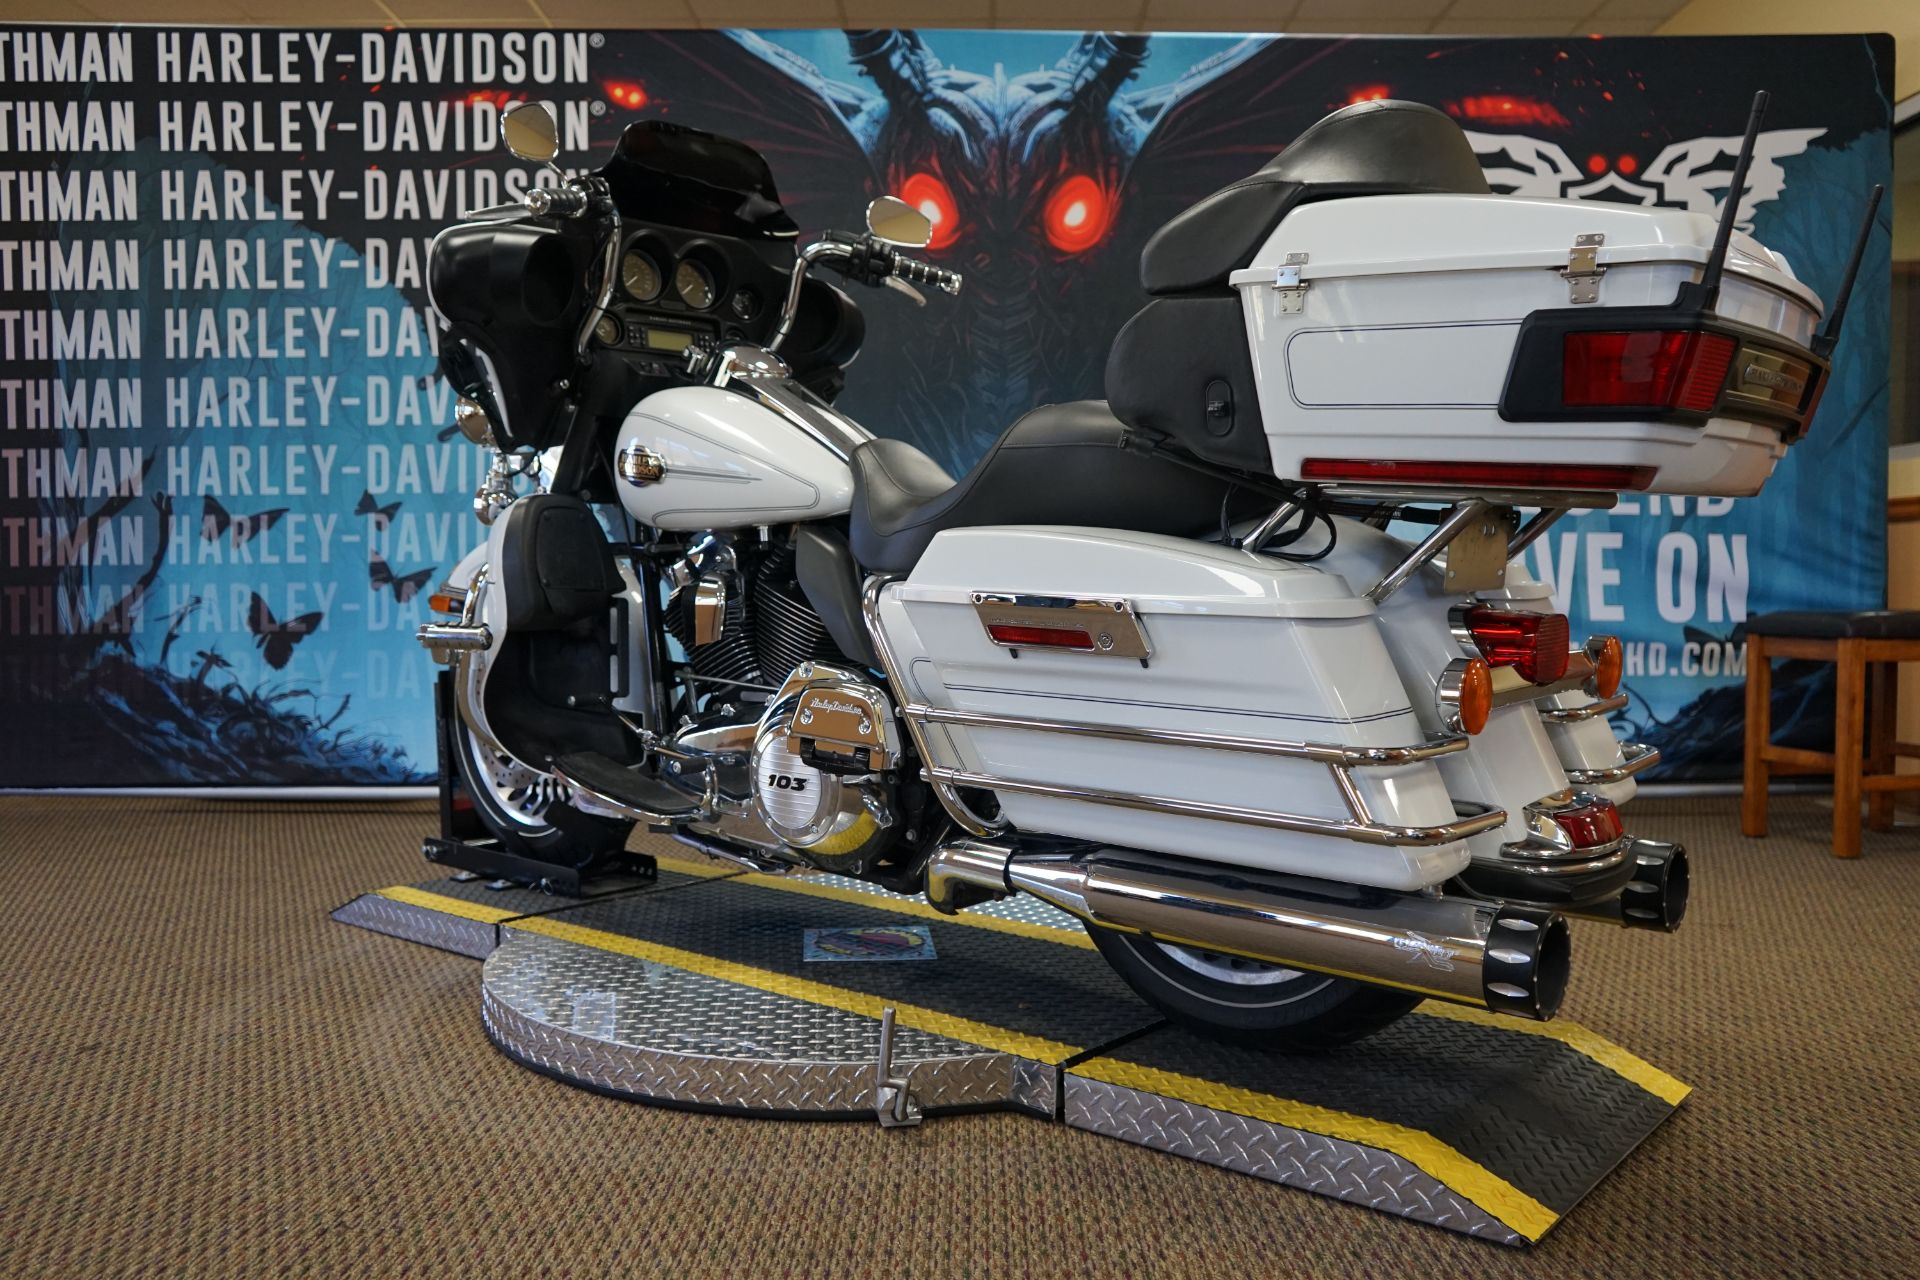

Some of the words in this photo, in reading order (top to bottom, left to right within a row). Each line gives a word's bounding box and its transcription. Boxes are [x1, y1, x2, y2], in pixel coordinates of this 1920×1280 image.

[0, 101, 135, 151] THMAN
[159, 100, 606, 151] HARLEY-DAVIDN®
[0, 170, 137, 221] THMAN
[161, 168, 589, 221] HARLEY-DAVIDS
[0, 240, 139, 290] THMAN
[163, 238, 433, 290] HARLEY-DA
[0, 310, 140, 360] THMAN
[1, 378, 142, 429] THMAN
[2, 448, 143, 498] THMAN
[3, 517, 143, 567] THMAN
[1656, 532, 1749, 623] ON
[4, 586, 144, 636] THMAN
[1619, 641, 1747, 678] HD.COM
[768, 774, 808, 792] 103
